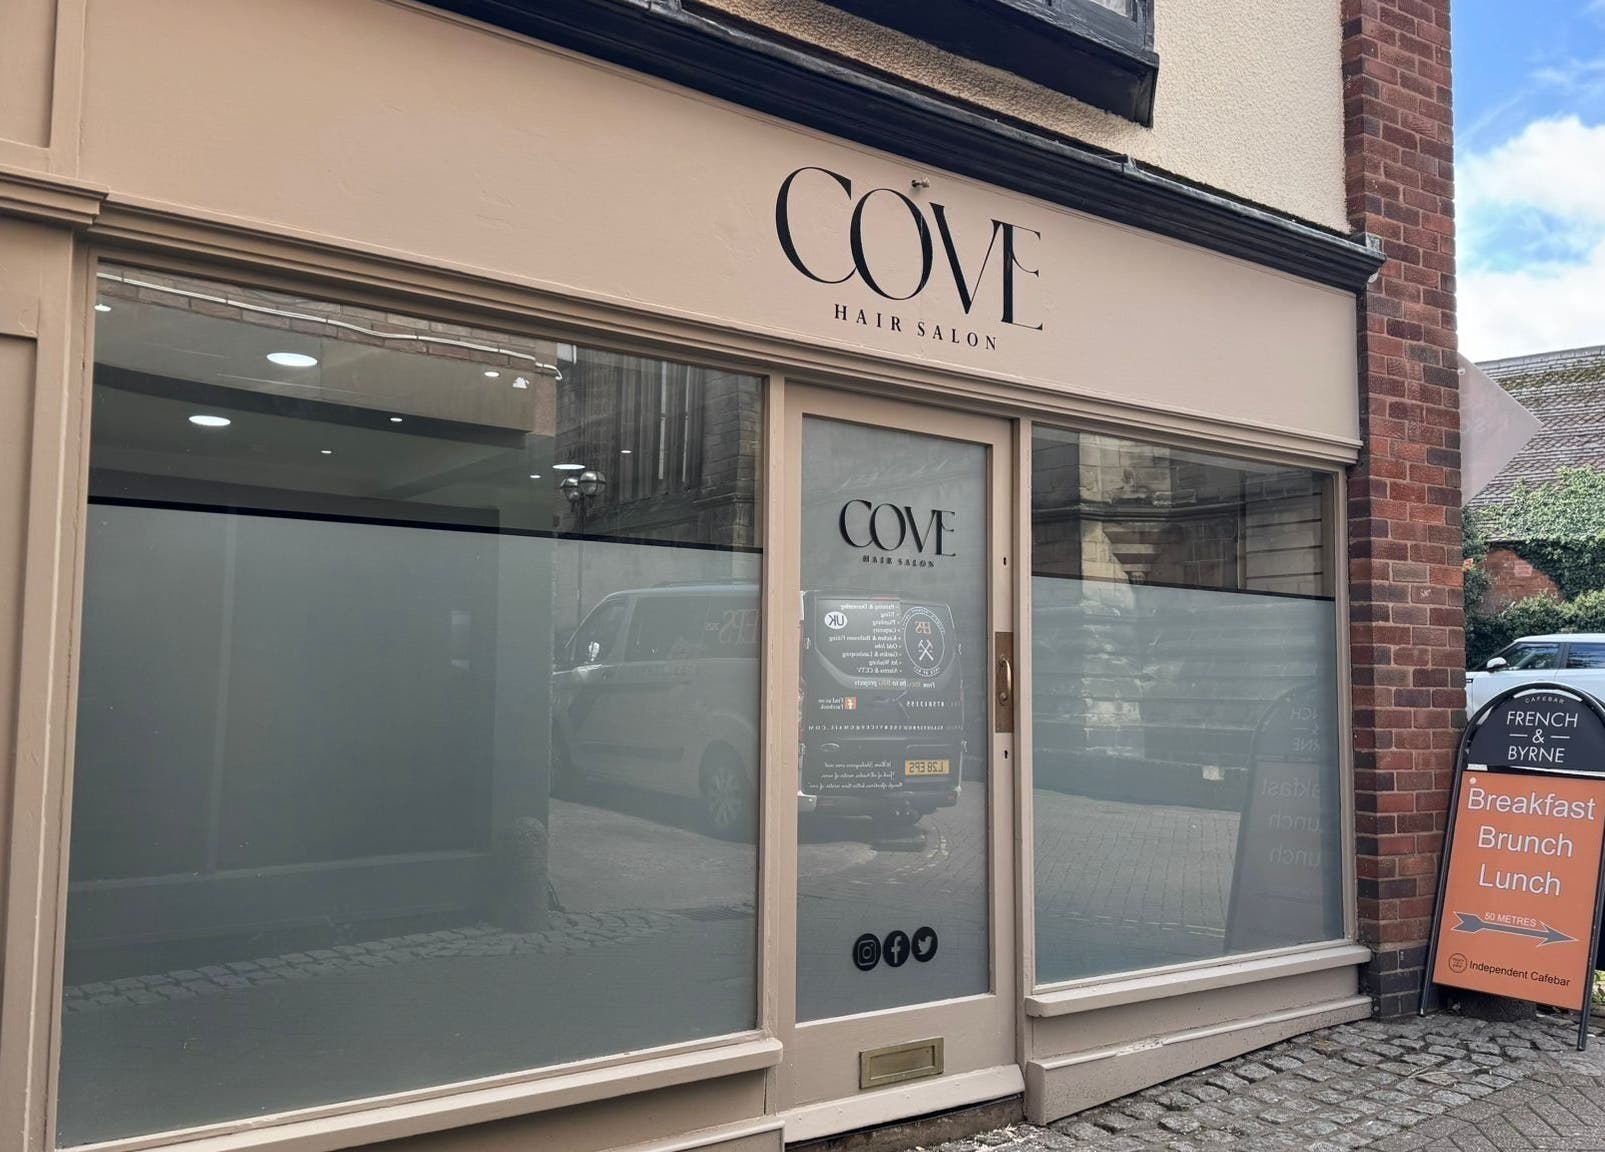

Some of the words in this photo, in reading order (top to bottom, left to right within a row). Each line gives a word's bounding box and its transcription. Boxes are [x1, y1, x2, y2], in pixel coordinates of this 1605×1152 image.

[775, 166, 1043, 331] COVE
[833, 303, 902, 332] HAIR
[917, 321, 998, 351] SALON
[838, 499, 956, 557] COVE
[862, 555, 893, 565] HAIR
[898, 559, 935, 568] SALON
[1506, 711, 1579, 728] FRENCH
[1532, 728, 1545, 744] &
[1507, 746, 1565, 763] BYRNE
[1467, 788, 1595, 820] Breakfast
[1477, 826, 1573, 857] Brunch
[1478, 864, 1561, 896] Lunch
[1485, 912, 1496, 922] 50
[1497, 914, 1537, 928] METRES
[1469, 960, 1528, 980] Independent
[1530, 972, 1570, 987] Cafebar
